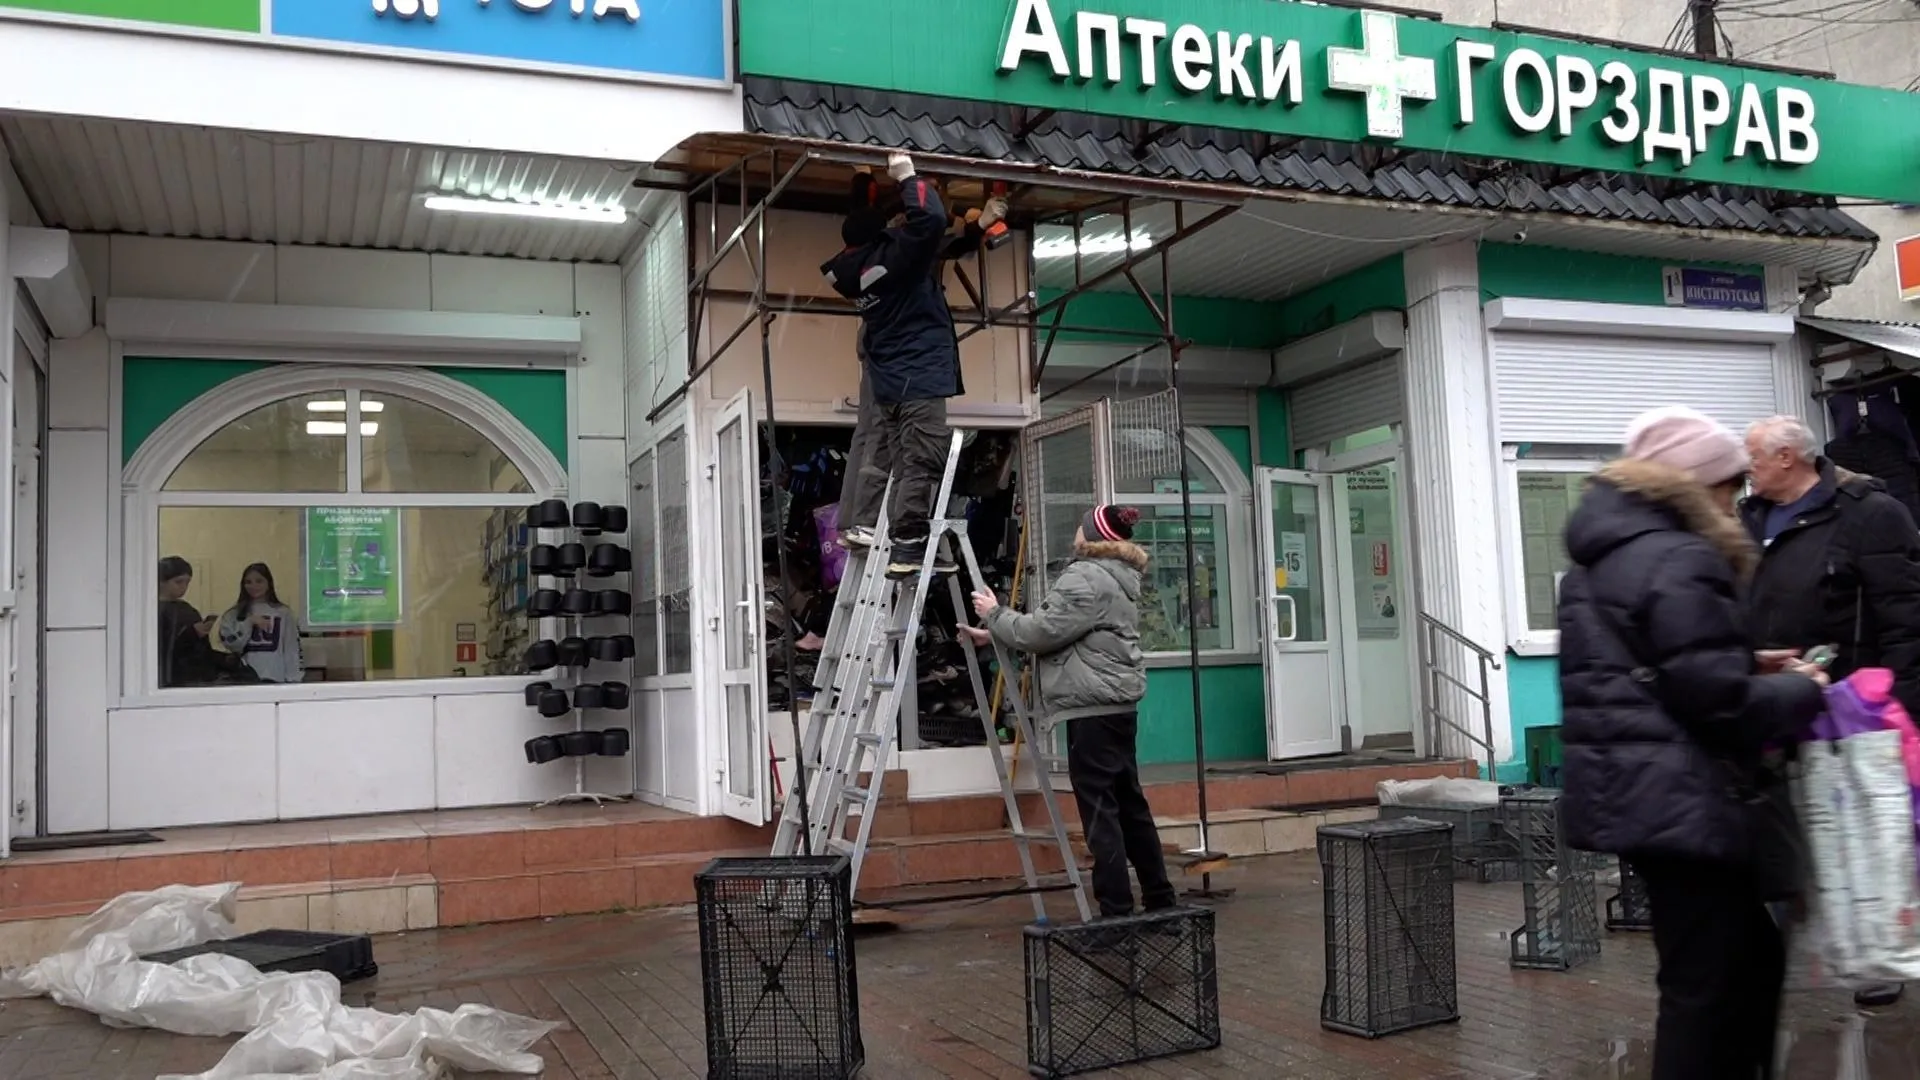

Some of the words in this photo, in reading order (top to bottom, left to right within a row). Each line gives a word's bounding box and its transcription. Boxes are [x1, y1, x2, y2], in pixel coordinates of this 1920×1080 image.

[997, 0, 1303, 105] Аптеки
[1454, 39, 1820, 167] ГОРЗДРАВ
[1685, 284, 1762, 304] ИНСТИТУТСКАЯ
[1285, 552, 1300, 572] 15
